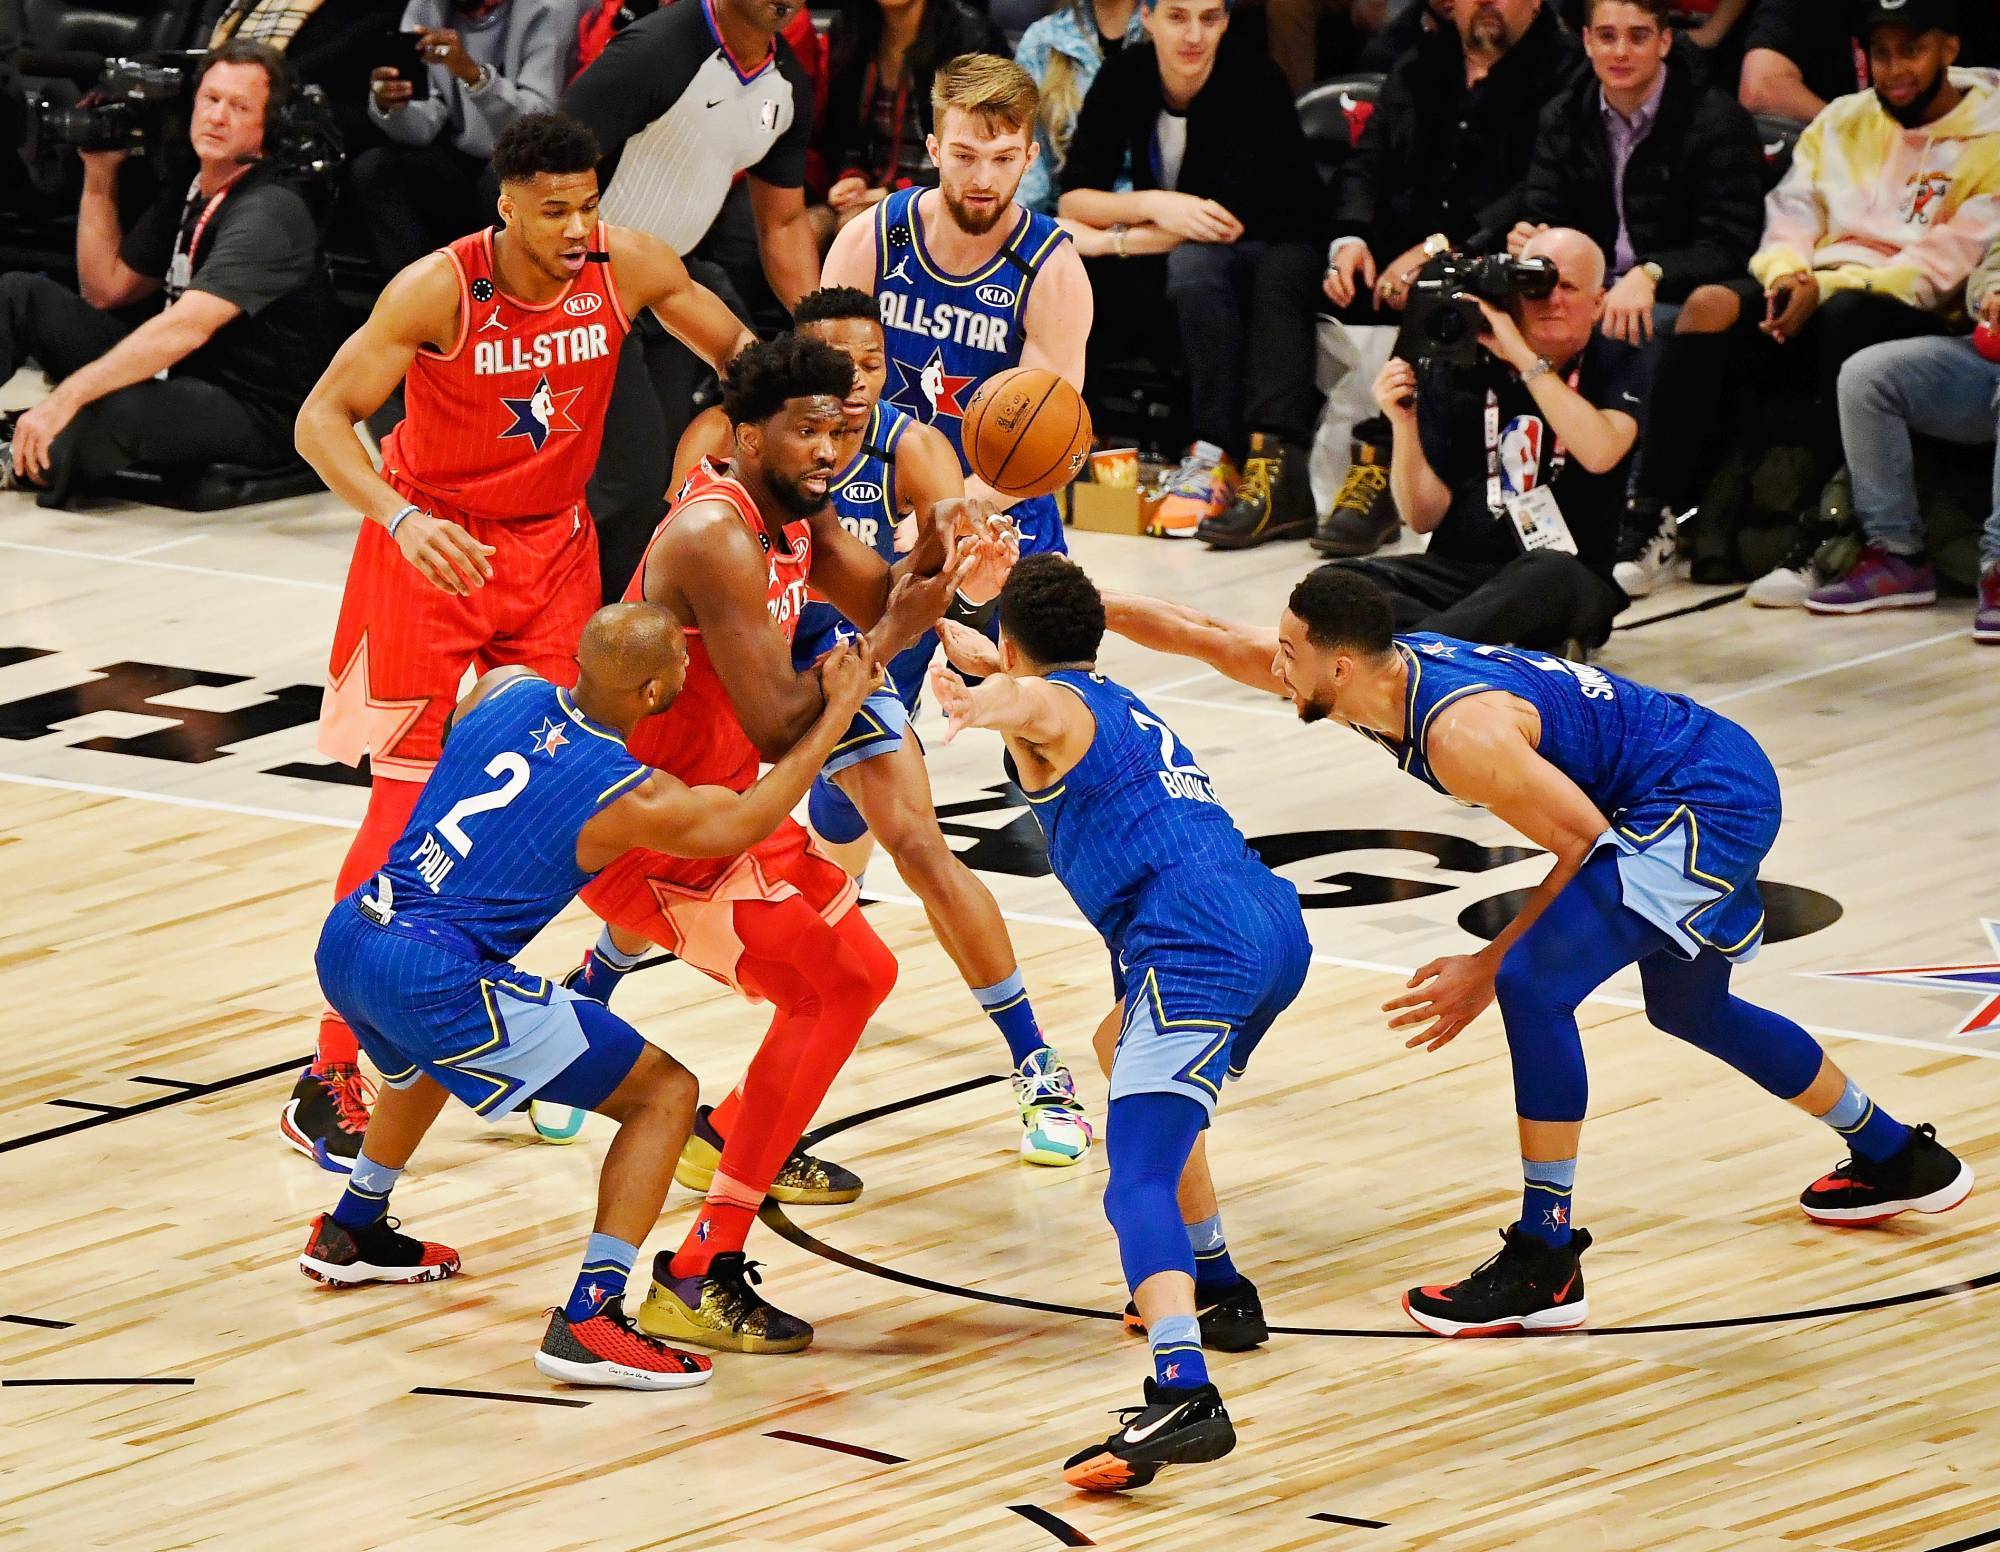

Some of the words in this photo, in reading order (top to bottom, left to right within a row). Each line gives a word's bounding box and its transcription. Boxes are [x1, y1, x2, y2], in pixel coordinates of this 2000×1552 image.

[474, 323, 609, 375] ALL-STAR
[879, 290, 1009, 353] ALL-STAR
[435, 751, 531, 859] 2
[409, 832, 455, 894] PAUL
